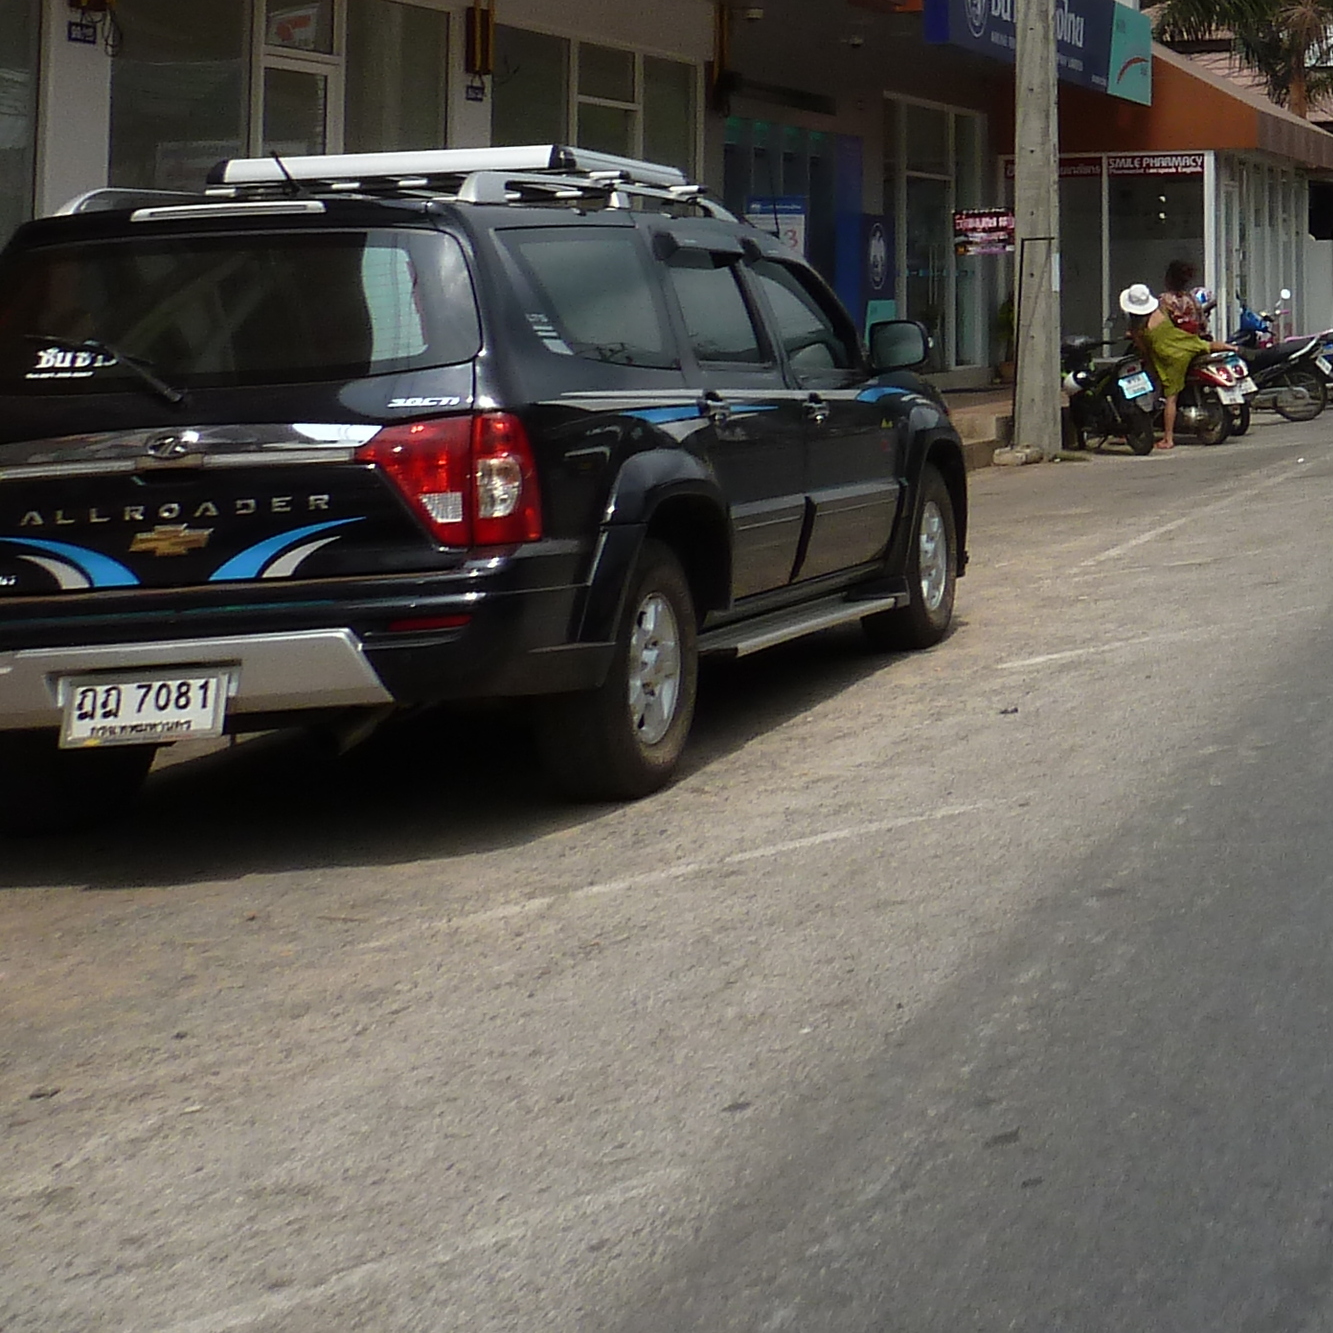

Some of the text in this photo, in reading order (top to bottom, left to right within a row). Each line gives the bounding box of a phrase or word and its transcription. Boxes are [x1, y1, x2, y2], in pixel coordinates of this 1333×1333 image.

[1108, 155, 1204, 167] SMILE PHARMACY
[20, 494, 331, 527] ALLROADER
[135, 679, 210, 714] 7081
